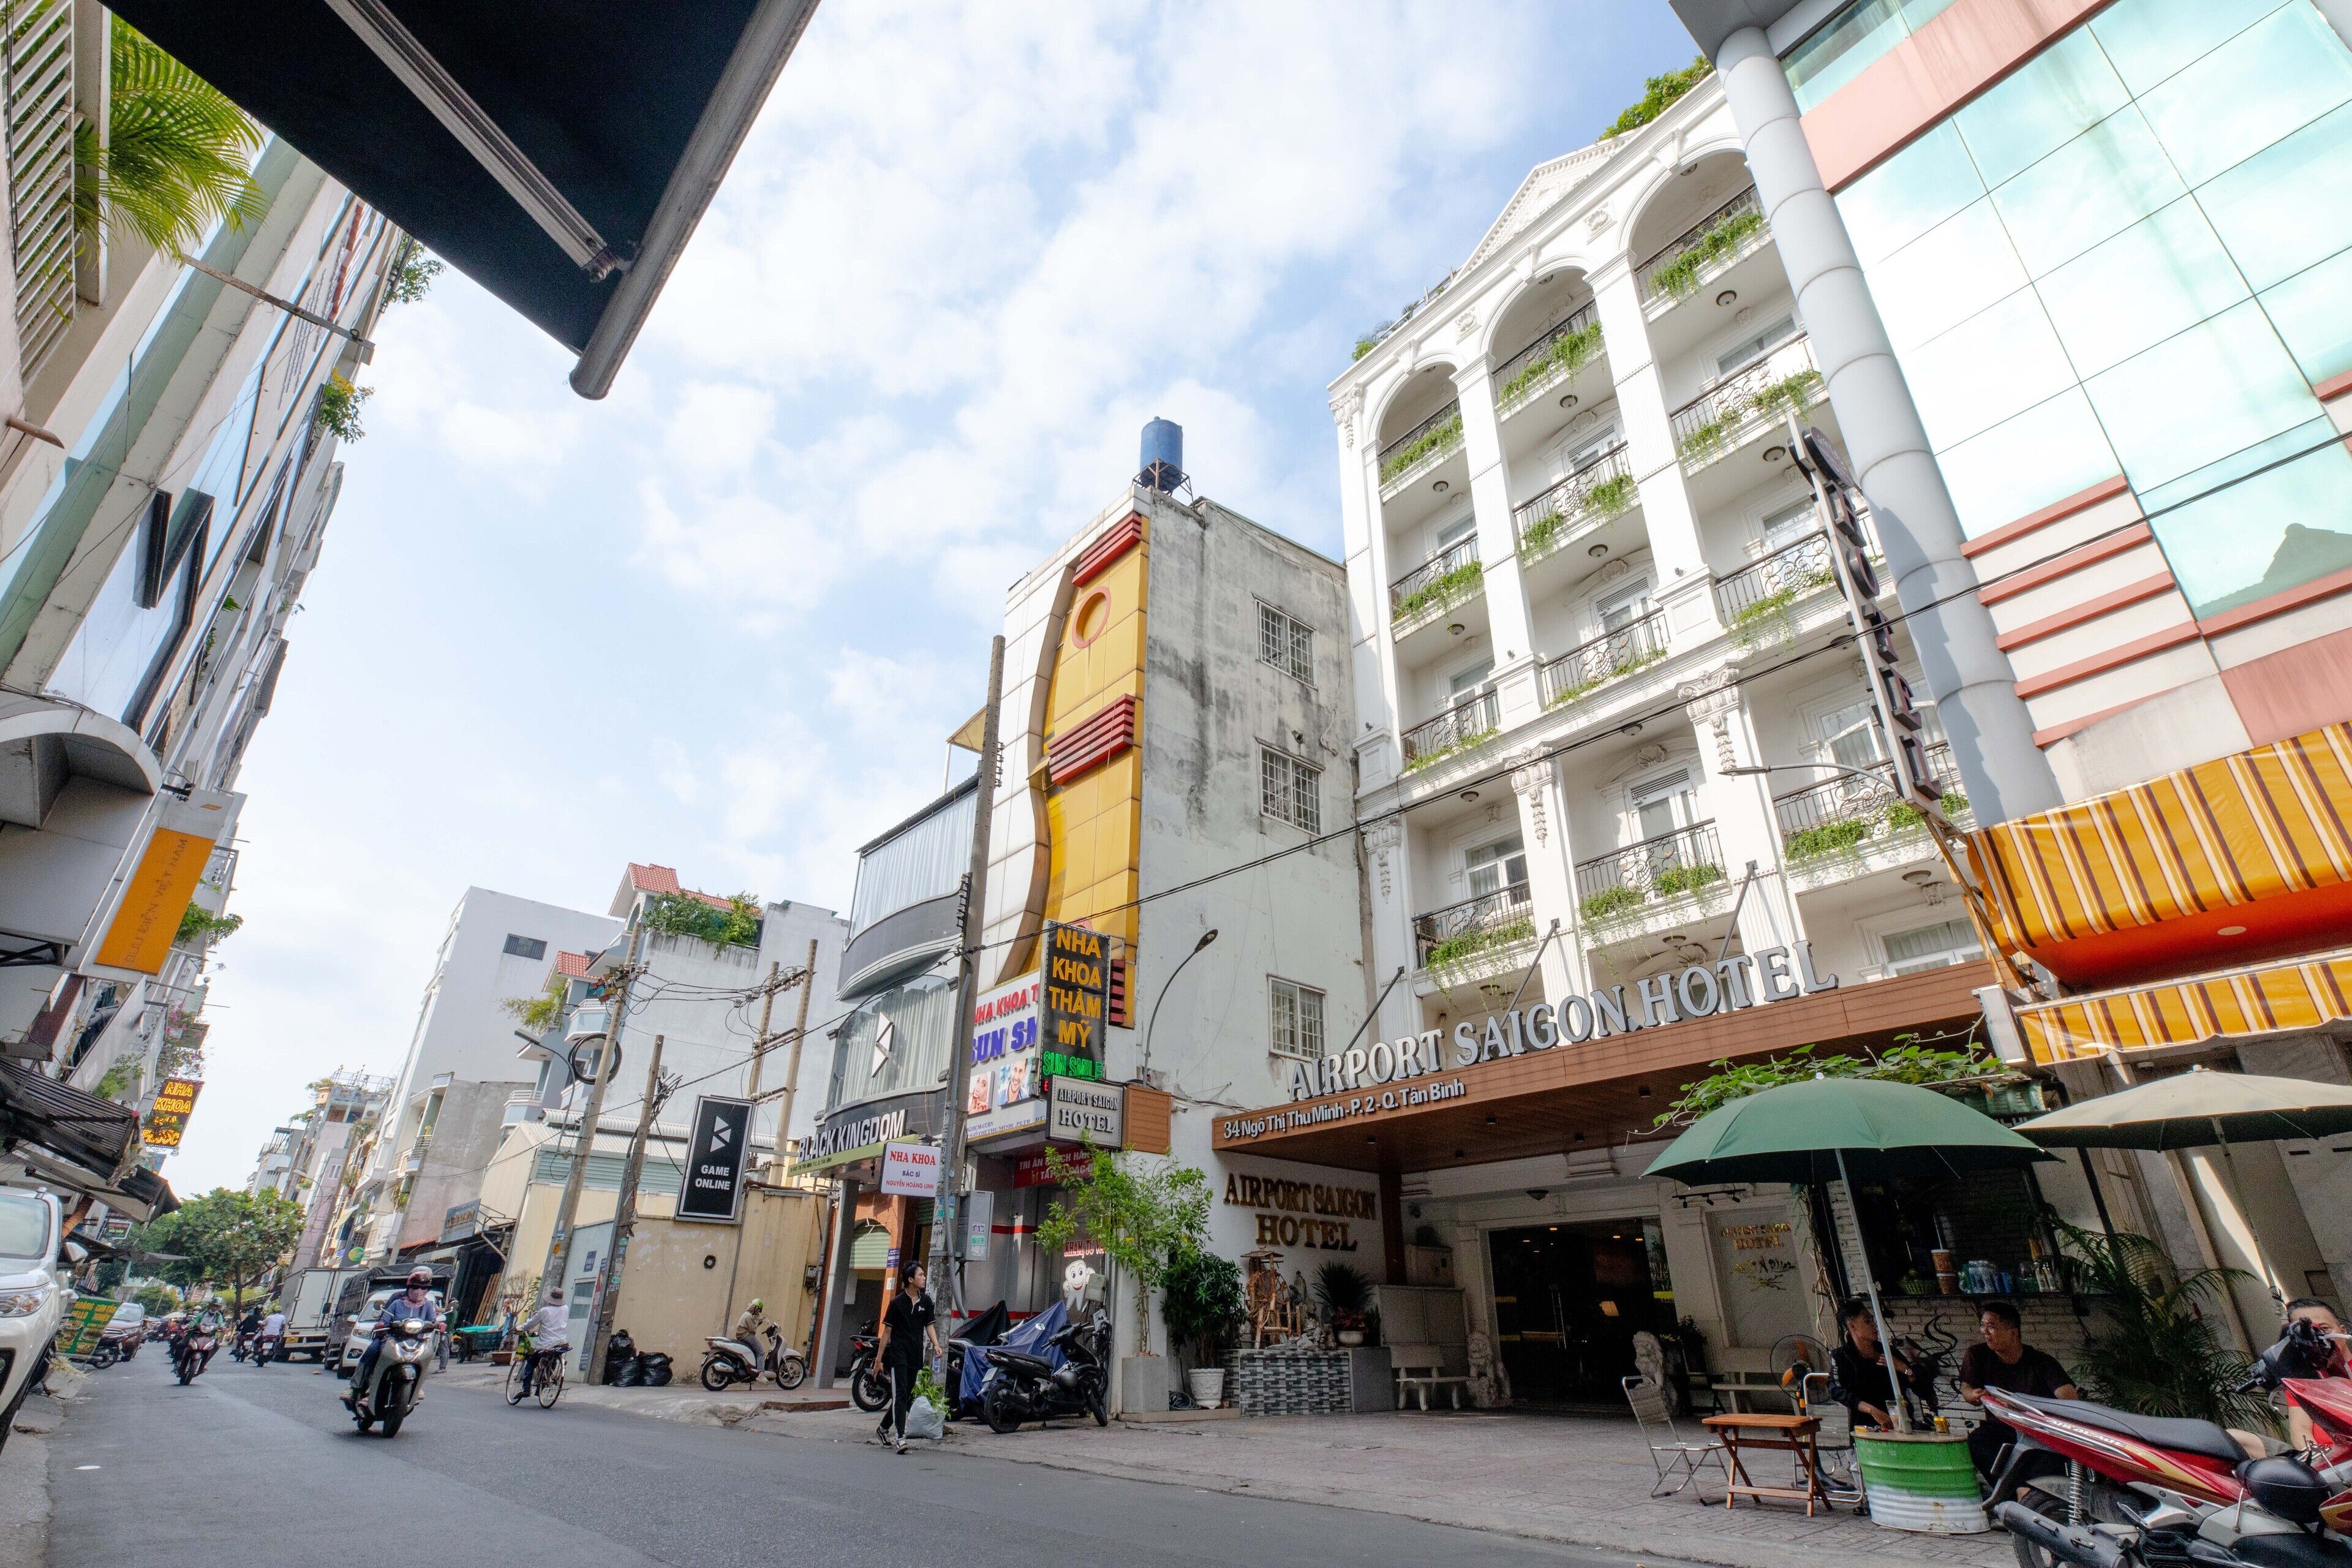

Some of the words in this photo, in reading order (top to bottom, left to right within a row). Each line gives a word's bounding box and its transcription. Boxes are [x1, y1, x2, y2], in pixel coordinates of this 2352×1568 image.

[170, 839, 188, 866] NAM
[1056, 927, 1101, 959] NHA
[1052, 956, 1102, 989] KHOA
[997, 989, 1029, 1016] KHOA
[1049, 986, 1101, 1019] THẨM
[1058, 1019, 1093, 1049] MỸ
[1289, 1028, 1446, 1102] AIRPORT
[1453, 984, 1629, 1068] SAIGON
[1636, 939, 1839, 1028] HOTEL
[1042, 1050, 1068, 1076] SUN
[1069, 1056, 1104, 1080] SMILE
[164, 1082, 195, 1097] NHA
[1058, 1088, 1091, 1106] AIRPORT
[1092, 1095, 1119, 1110] SAIGON
[154, 1097, 192, 1114] KHOA
[1224, 1120, 1241, 1139] 34
[1241, 1118, 1266, 1138] Ngô
[1267, 1112, 1287, 1132] Thị
[1286, 1110, 1311, 1128] Thu
[1312, 1102, 1344, 1123] Minh
[1382, 1091, 1399, 1109] Q.
[1400, 1087, 1428, 1106] Tân
[1430, 1078, 1466, 1101] Bình
[1060, 1109, 1115, 1133] HOTEL
[798, 1128, 837, 1163] BLACK
[836, 1109, 908, 1153] KINGDOM
[701, 1164, 730, 1177] GAME
[890, 1151, 909, 1163] NHA
[911, 1153, 937, 1166] KHOA
[1019, 1160, 1030, 1170] TRI
[1033, 1158, 1043, 1168] ÂN
[695, 1178, 731, 1191] ONLINE
[1223, 1174, 1311, 1213] AIRPORT
[1313, 1183, 1376, 1220] SAIGON
[1255, 1213, 1358, 1252] HOTEL
[2046, 1419, 2072, 1430] AIR
